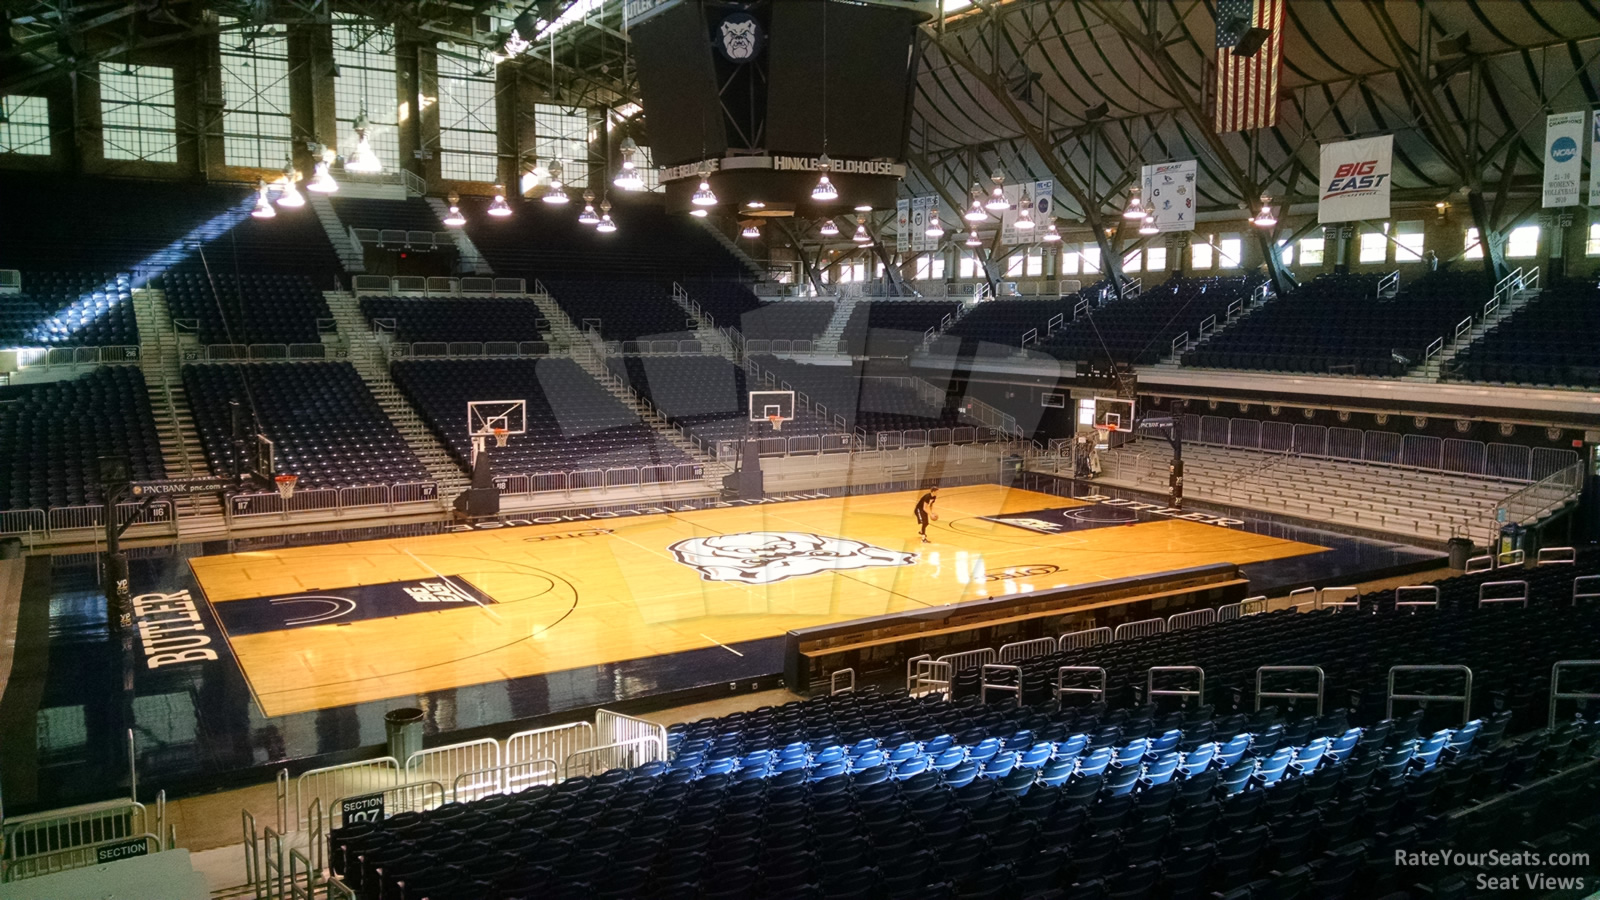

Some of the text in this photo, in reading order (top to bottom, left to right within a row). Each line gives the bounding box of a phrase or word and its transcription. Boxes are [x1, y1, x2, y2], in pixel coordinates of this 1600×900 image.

[1553, 148, 1576, 157] NCAA
[774, 156, 892, 174] HINKLE IELDHOUSE
[1334, 160, 1378, 178] BIG
[1327, 174, 1389, 192] EAST
[1544, 188, 1578, 196] VOLLEYBALL
[190, 484, 220, 492] pnc.com
[153, 508, 164, 516] 116
[238, 501, 248, 509] 117
[1073, 494, 1245, 527] BUTLER
[132, 589, 219, 669] BUTLER
[344, 798, 383, 812] SECTION
[99, 843, 146, 860] SECTION
